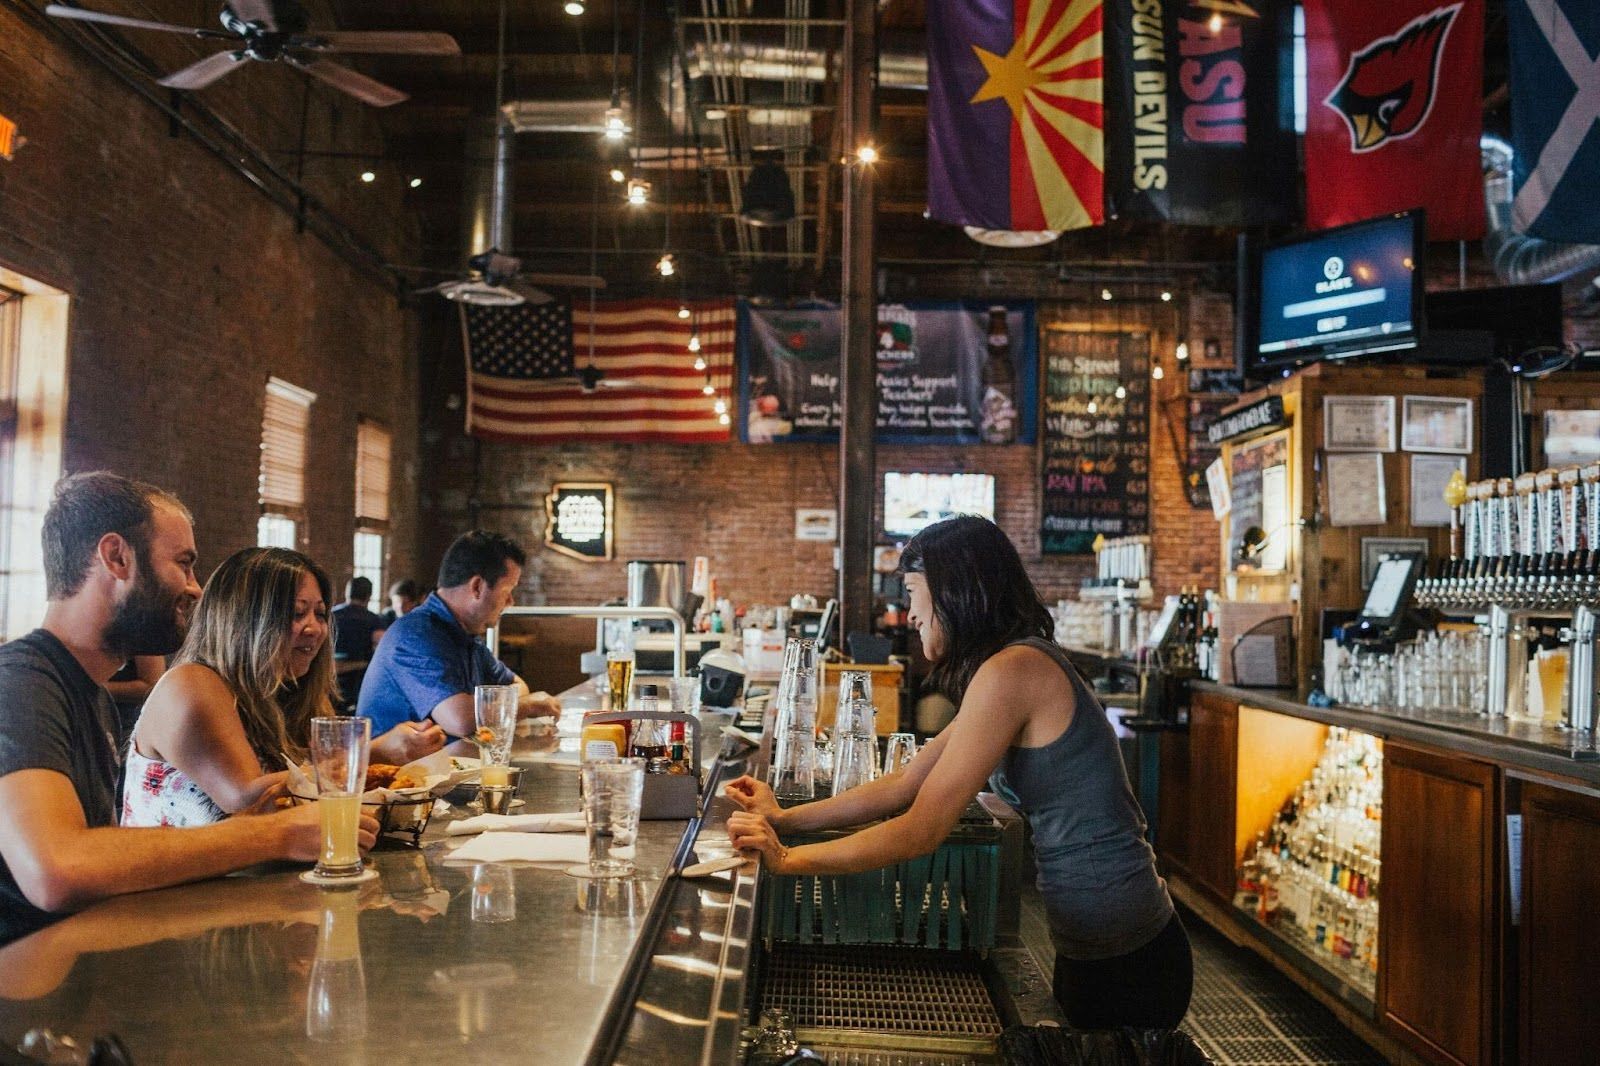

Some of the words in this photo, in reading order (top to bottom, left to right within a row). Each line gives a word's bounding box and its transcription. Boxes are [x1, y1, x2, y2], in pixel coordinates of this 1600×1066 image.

[1131, 0, 1165, 62] SUN
[1177, 17, 1248, 145] ASU
[1132, 71, 1168, 191] DEVILS
[911, 374, 957, 393] Support
